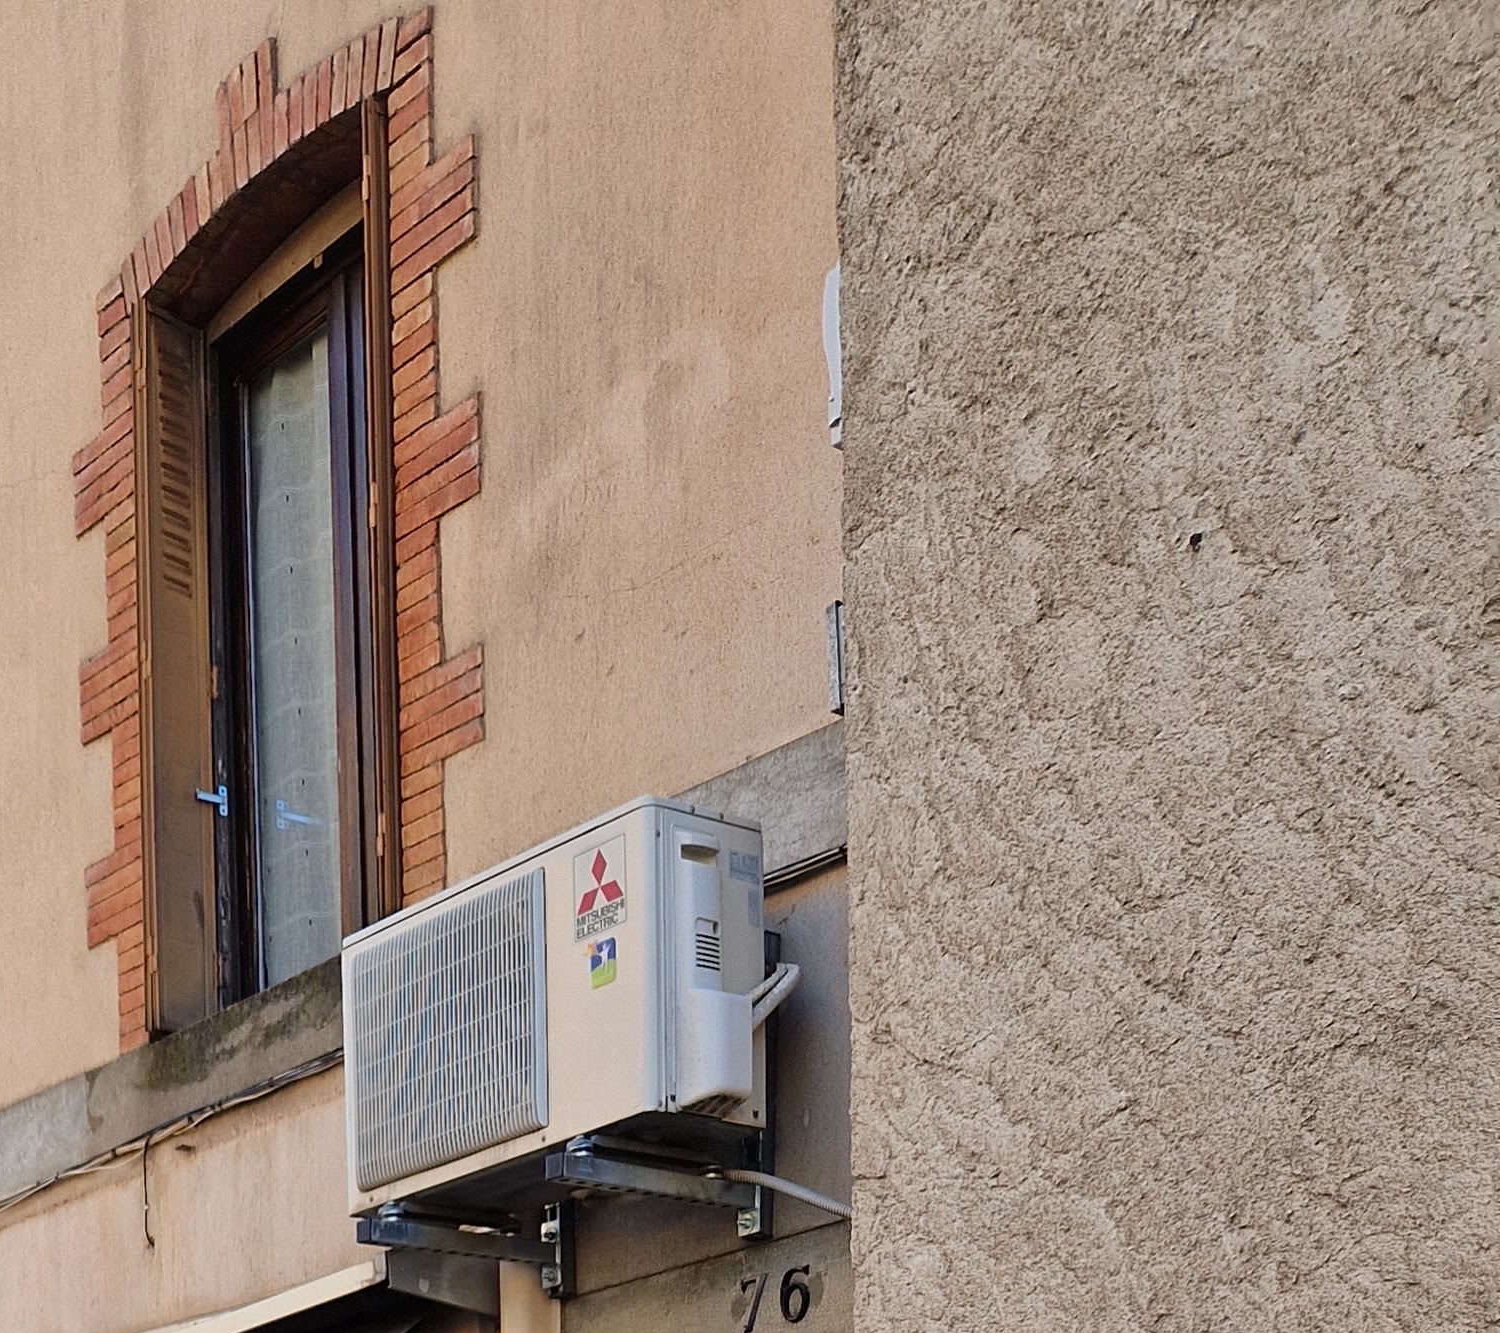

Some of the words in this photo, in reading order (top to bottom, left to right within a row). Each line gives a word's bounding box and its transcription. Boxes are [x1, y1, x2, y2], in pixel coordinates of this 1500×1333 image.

[576, 898, 625, 927] MITSUBISHI
[576, 912, 620, 941] ELECTRIC
[740, 1264, 810, 1333] 76
